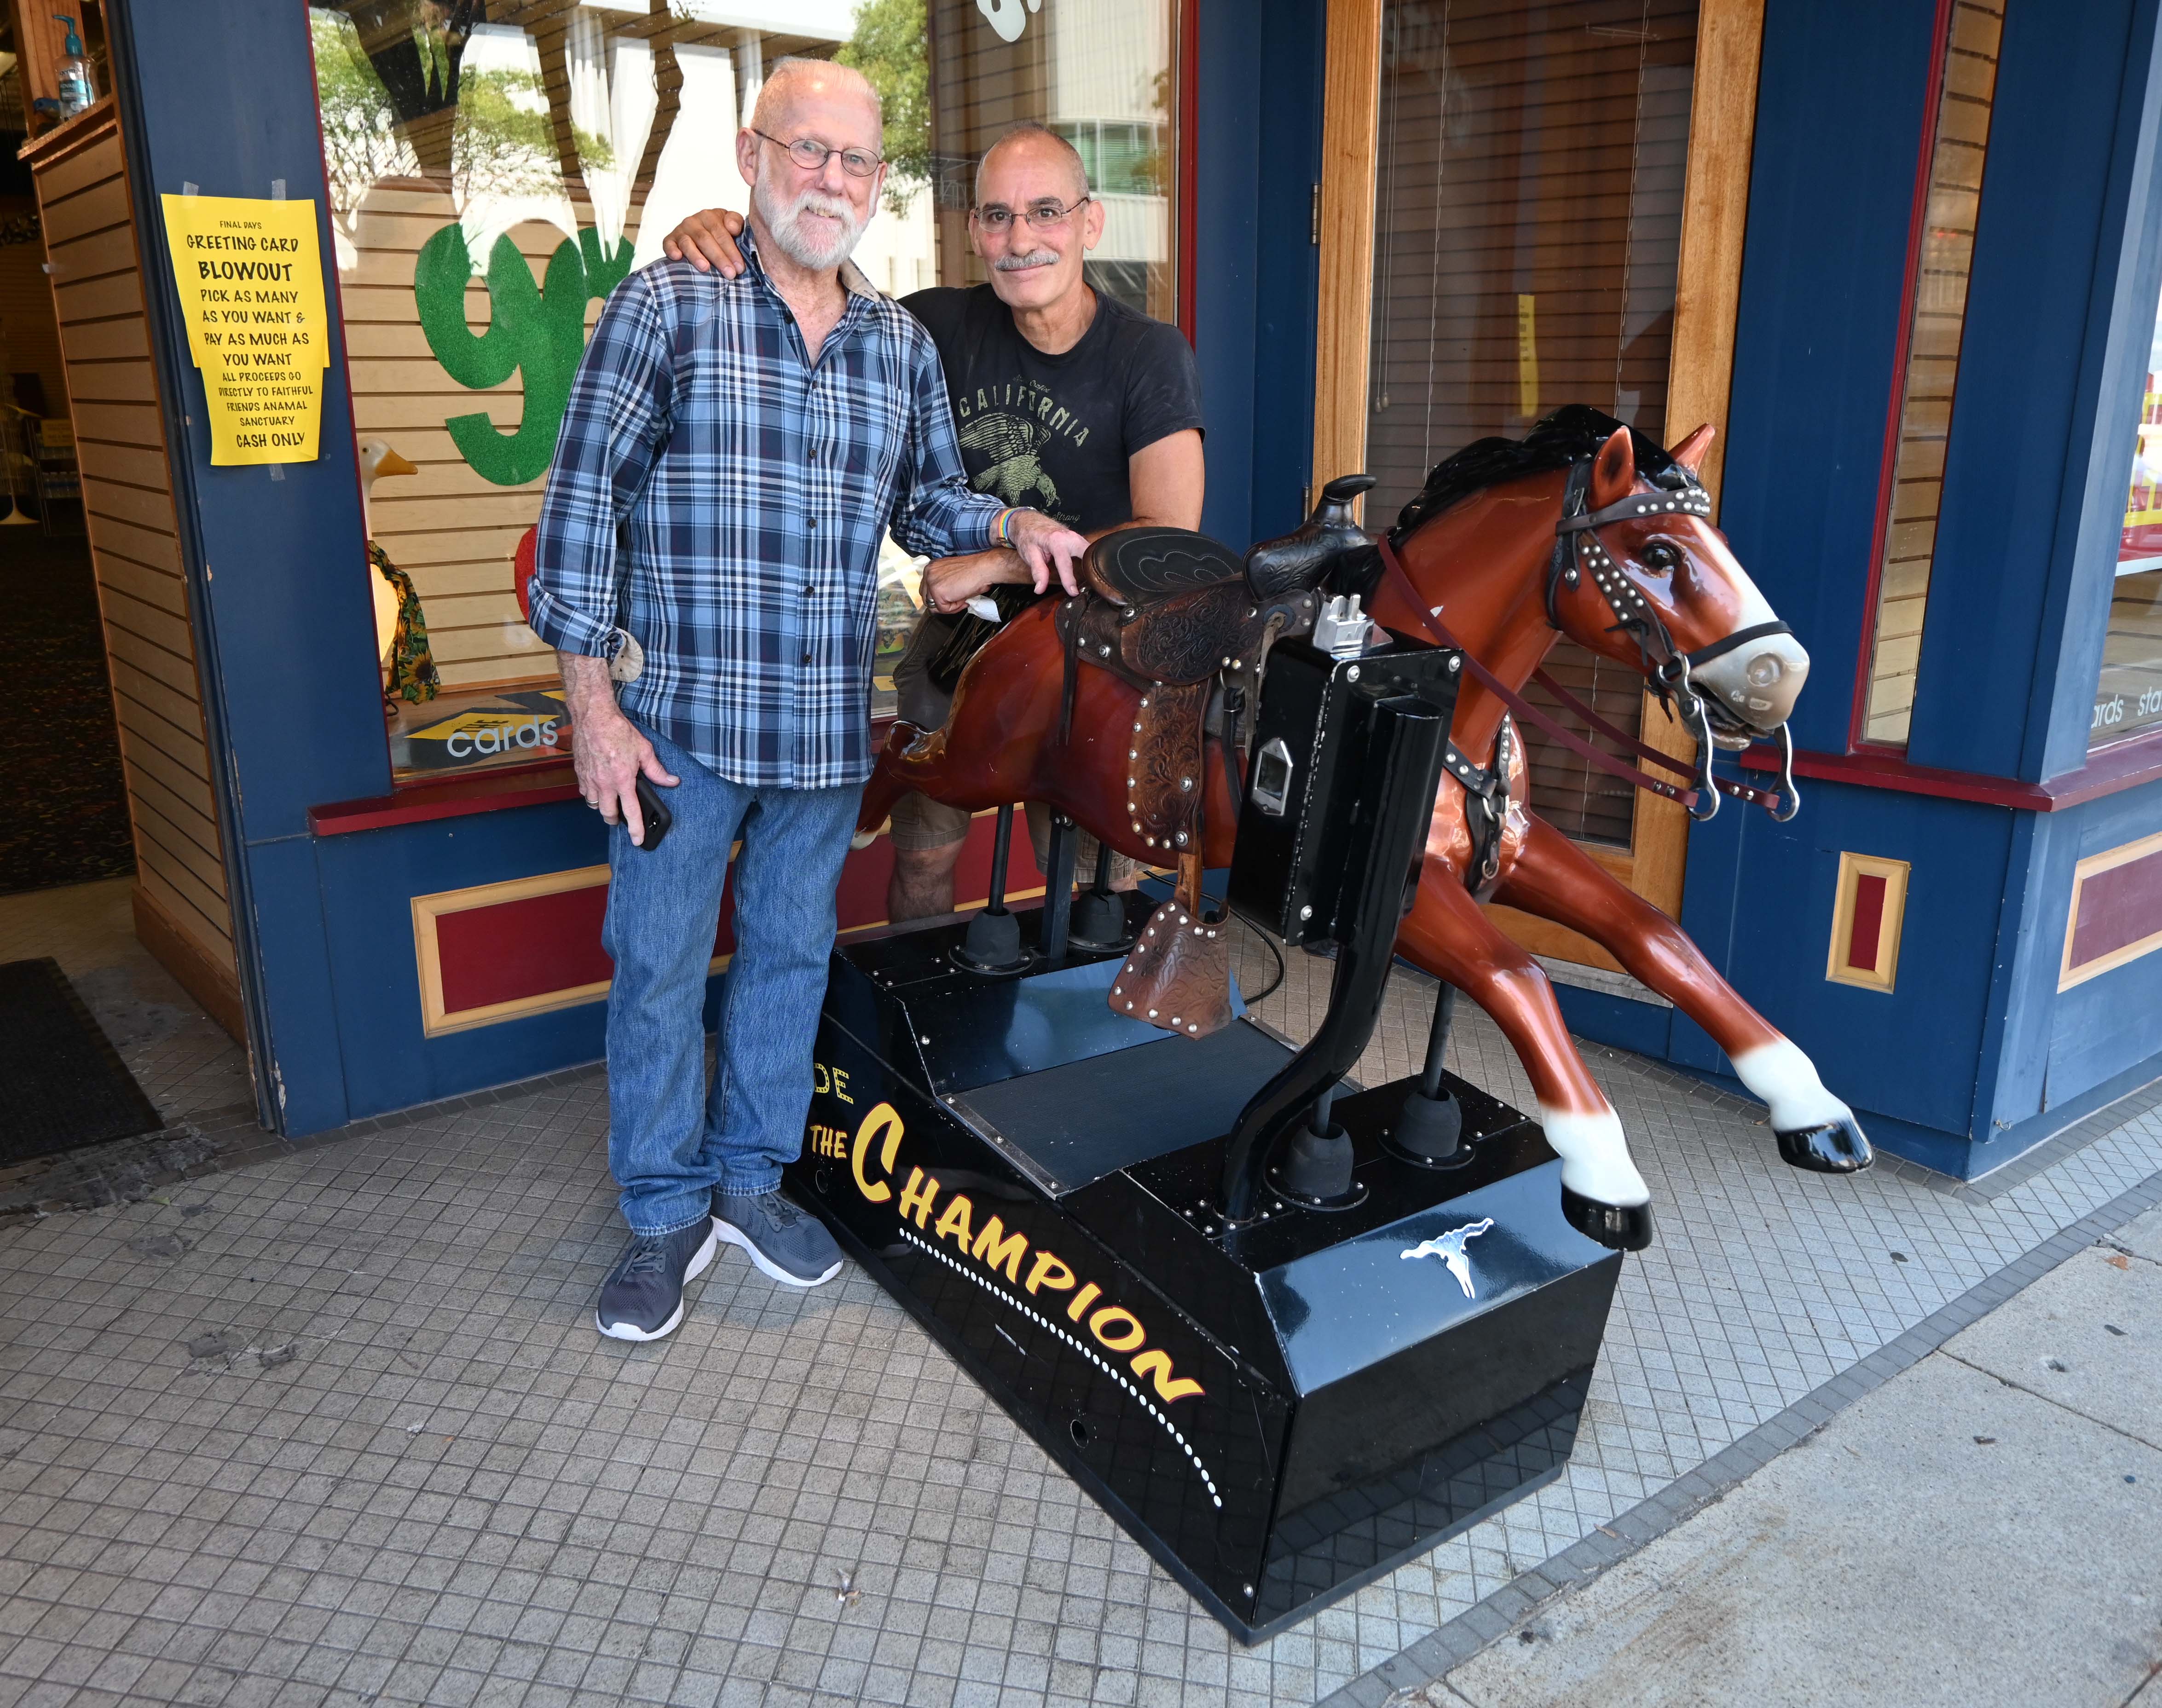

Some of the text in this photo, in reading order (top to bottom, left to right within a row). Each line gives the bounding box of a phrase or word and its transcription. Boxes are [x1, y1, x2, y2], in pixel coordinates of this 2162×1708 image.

[187, 234, 298, 252] GREETING CARD
[198, 261, 293, 282] BLOWOUT
[200, 289, 298, 303] PICK AS MANY
[202, 310, 305, 324] AS YOU WANT &
[204, 332, 309, 346] PAY AS MUCH AS
[222, 353, 292, 366] YOU WANT
[223, 371, 301, 382] ALL PROCEEDS GO
[218, 386, 313, 397] DIRECTLY TO FAITHFUL
[226, 400, 307, 412] FRIENDS ANAMAL
[240, 416, 295, 427] SANCTUARY
[959, 384, 1089, 446] CALIFORNIA
[236, 432, 305, 448] CASH ONLY
[2091, 686, 2162, 728] ards sta
[447, 714, 559, 757] cards
[813, 1062, 854, 1105] DE
[809, 1101, 1205, 1404] THE CHAMPION
